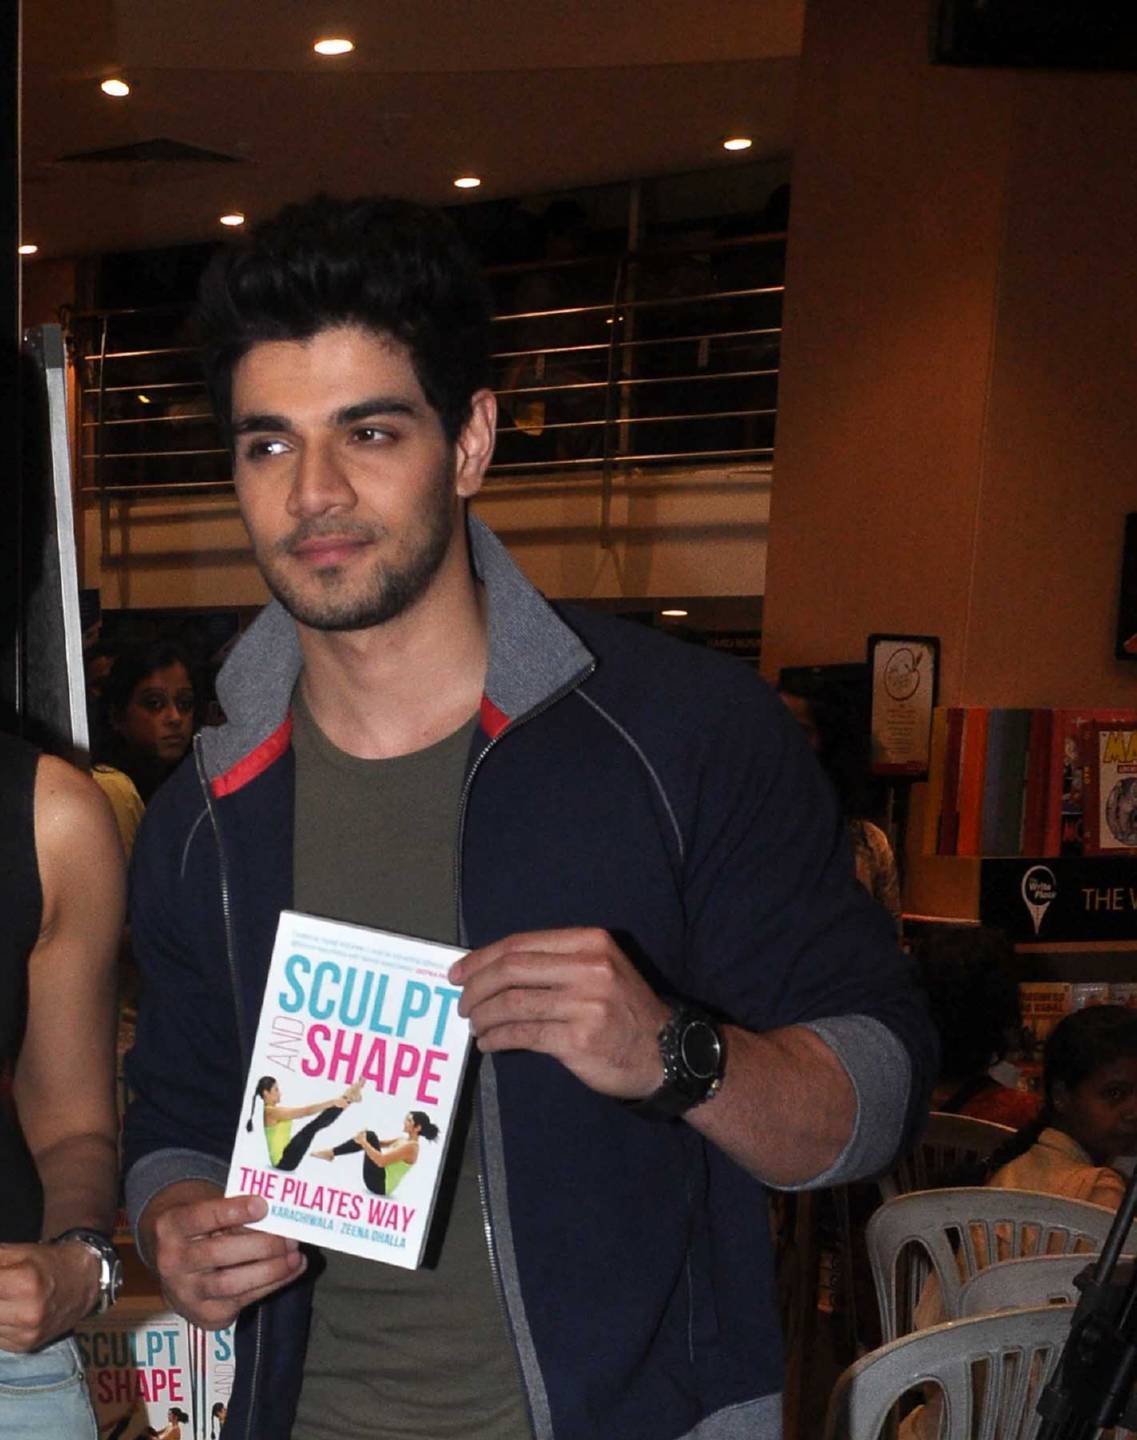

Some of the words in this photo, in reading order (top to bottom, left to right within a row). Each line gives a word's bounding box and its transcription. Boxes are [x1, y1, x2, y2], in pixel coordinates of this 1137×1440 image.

[1081, 887, 1125, 911] THE
[279, 954, 462, 1046] SCULPT
[266, 1014, 305, 1072] AND
[301, 1024, 448, 1105] SHAPE
[239, 1166, 279, 1200] THE
[280, 1177, 364, 1221] PILATES
[367, 1198, 416, 1233] WAY
[339, 1221, 370, 1240] ZEENA
[97, 1368, 184, 1403] SHAPE
